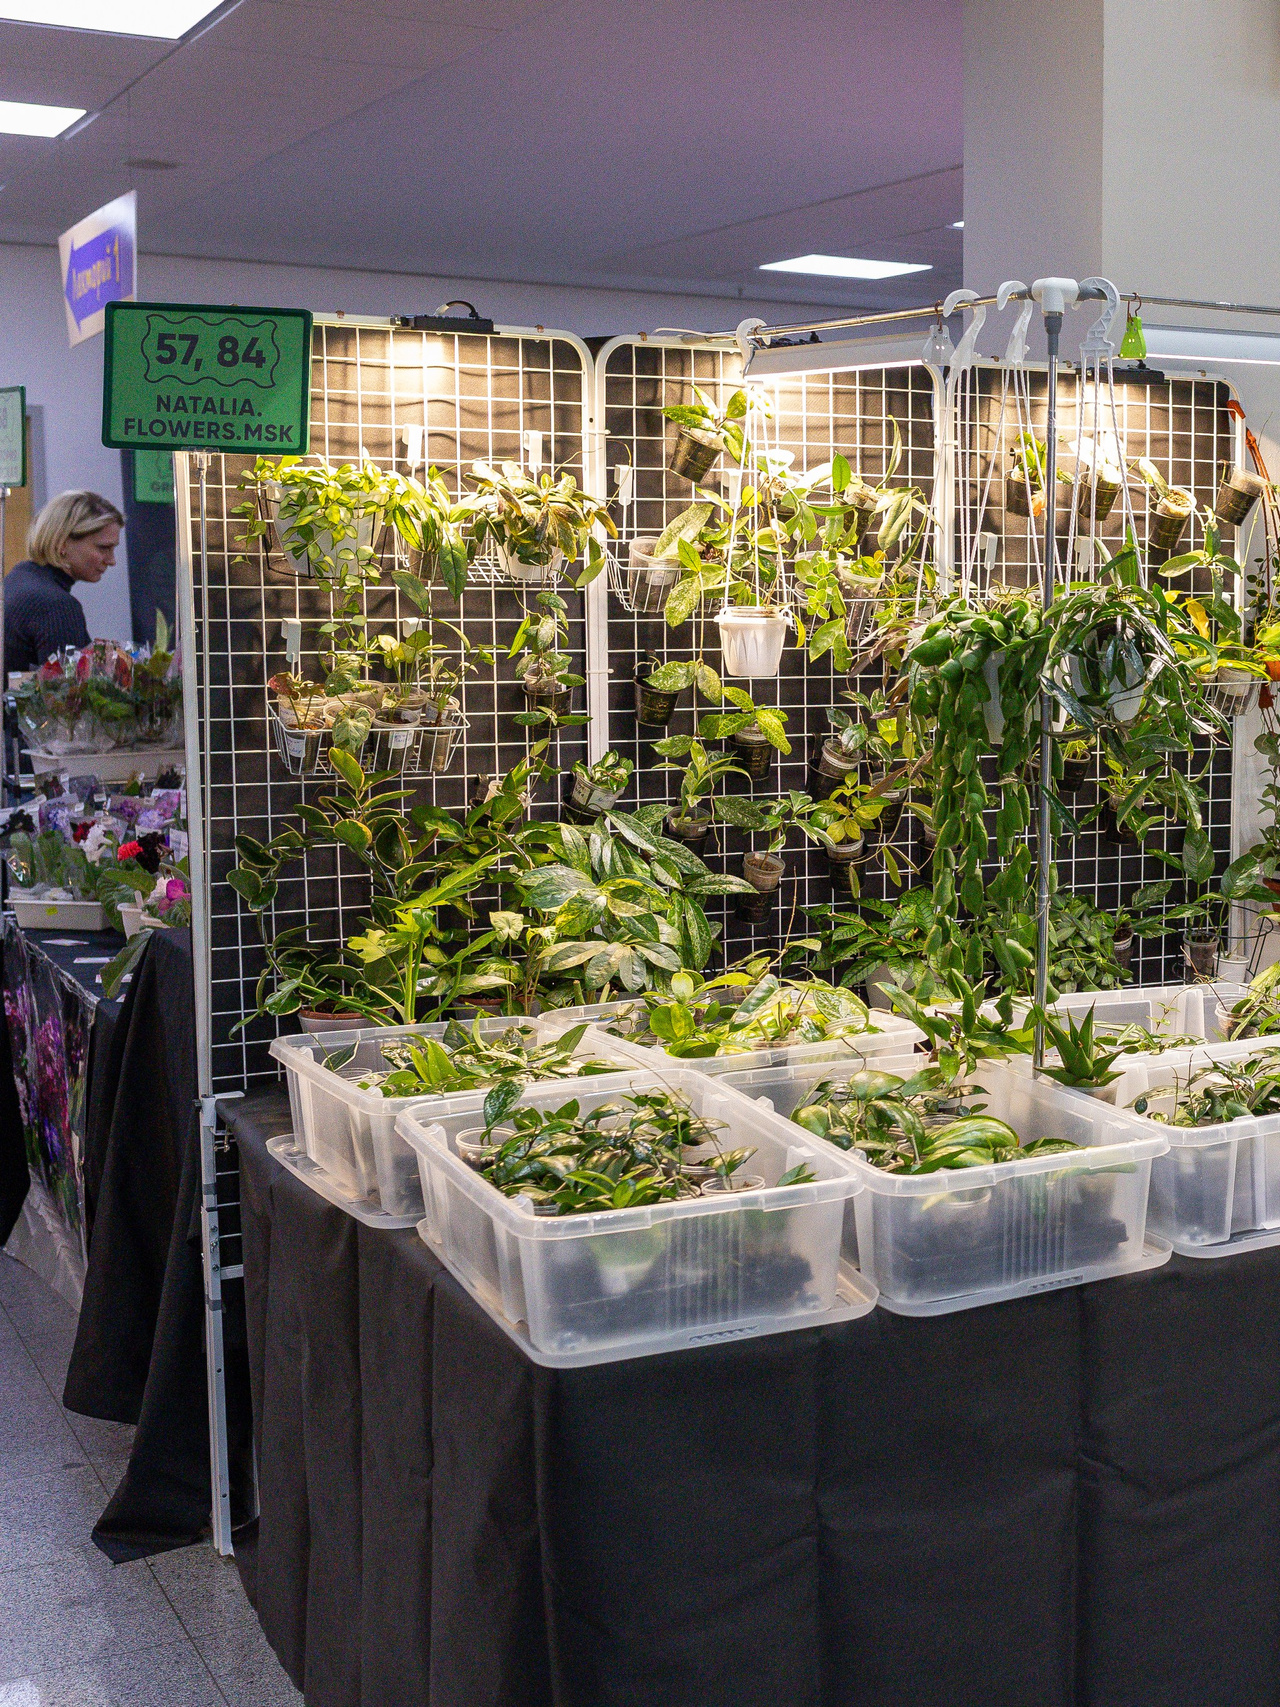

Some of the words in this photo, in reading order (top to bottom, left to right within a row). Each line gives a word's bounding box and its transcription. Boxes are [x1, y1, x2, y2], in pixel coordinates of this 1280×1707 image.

[155, 332, 203, 372] 57,
[217, 335, 266, 369] 84
[156, 394, 263, 417] NATALIA.
[123, 417, 294, 443] FLOWERS.MSK
